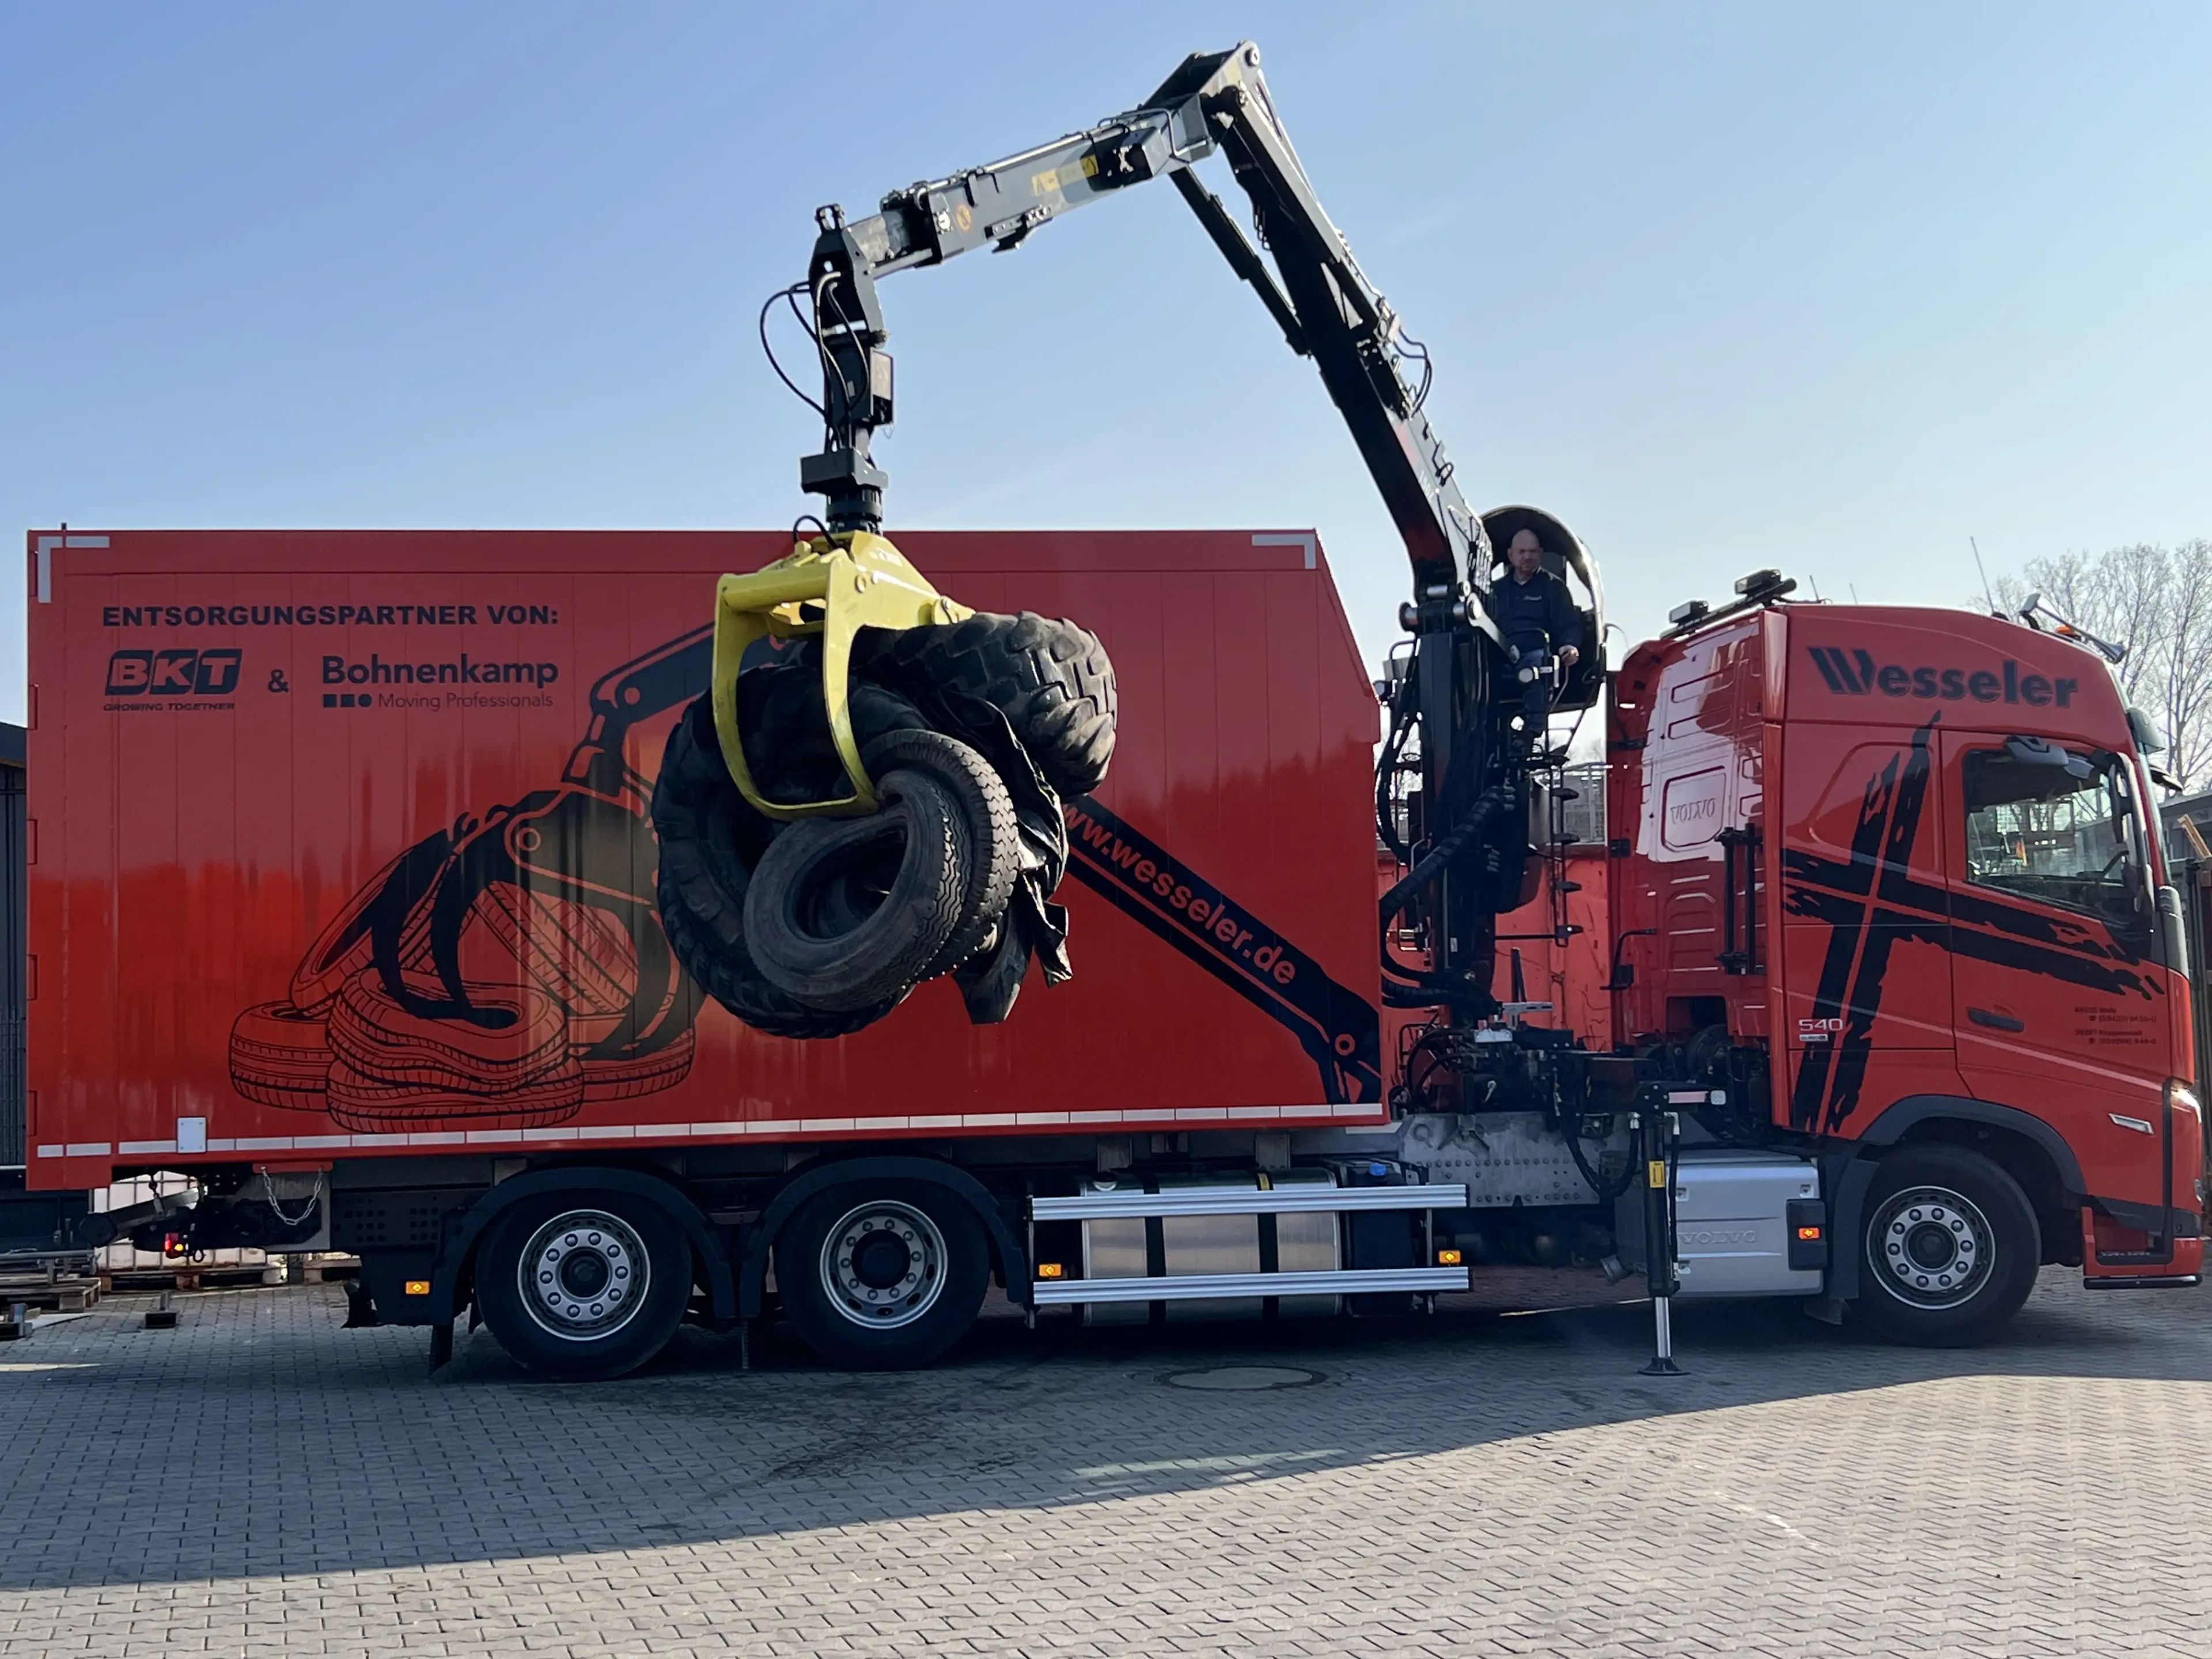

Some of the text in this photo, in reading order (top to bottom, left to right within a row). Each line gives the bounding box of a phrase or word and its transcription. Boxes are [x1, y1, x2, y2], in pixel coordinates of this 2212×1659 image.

[103, 605, 559, 626] ENTSORGUNGSPARTNER VON:
[105, 651, 240, 693] BKT
[267, 668, 289, 694] &
[322, 653, 559, 689] Bohnenkamp
[1806, 646, 2078, 709] Wesseler
[103, 702, 236, 711] GROWING TOGETHER
[378, 692, 554, 712] Moving Professionals
[1670, 797, 1717, 825] VOLVO
[1062, 804, 1296, 984] ww.wesseler.de
[1798, 1018, 1843, 1032] 540
[1676, 1230, 1758, 1245] VOLVO
